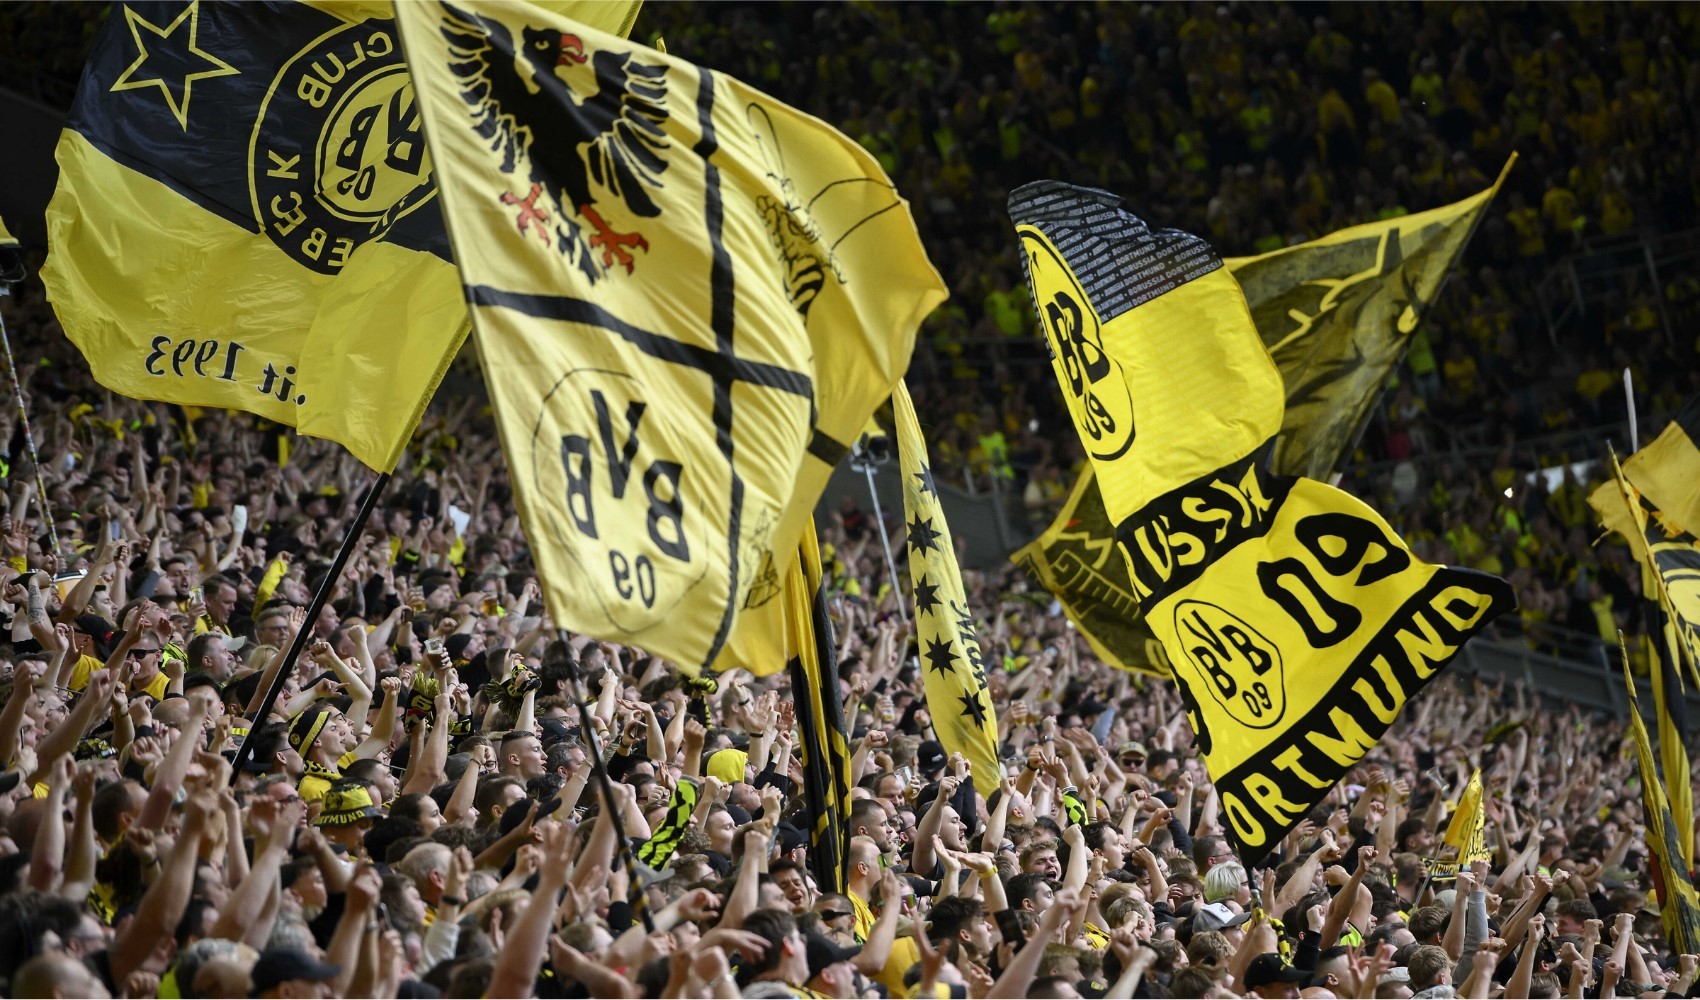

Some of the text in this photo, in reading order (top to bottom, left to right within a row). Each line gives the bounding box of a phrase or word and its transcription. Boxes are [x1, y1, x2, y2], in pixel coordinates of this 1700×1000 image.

[1116, 242, 1157, 266] DORTMUND
[1120, 255, 1157, 276] BORUSSIA
[1124, 262, 1166, 286] DORTMUND
[1128, 274, 1166, 296] BORUSSIA
[1165, 254, 1210, 279] DORTMUND
[1132, 281, 1176, 306] DORTMUND
[1256, 512, 1411, 649] 09
[1181, 609, 1273, 701] BVB
[1222, 585, 1494, 848] ORTMUND
[1242, 681, 1273, 718] 09
